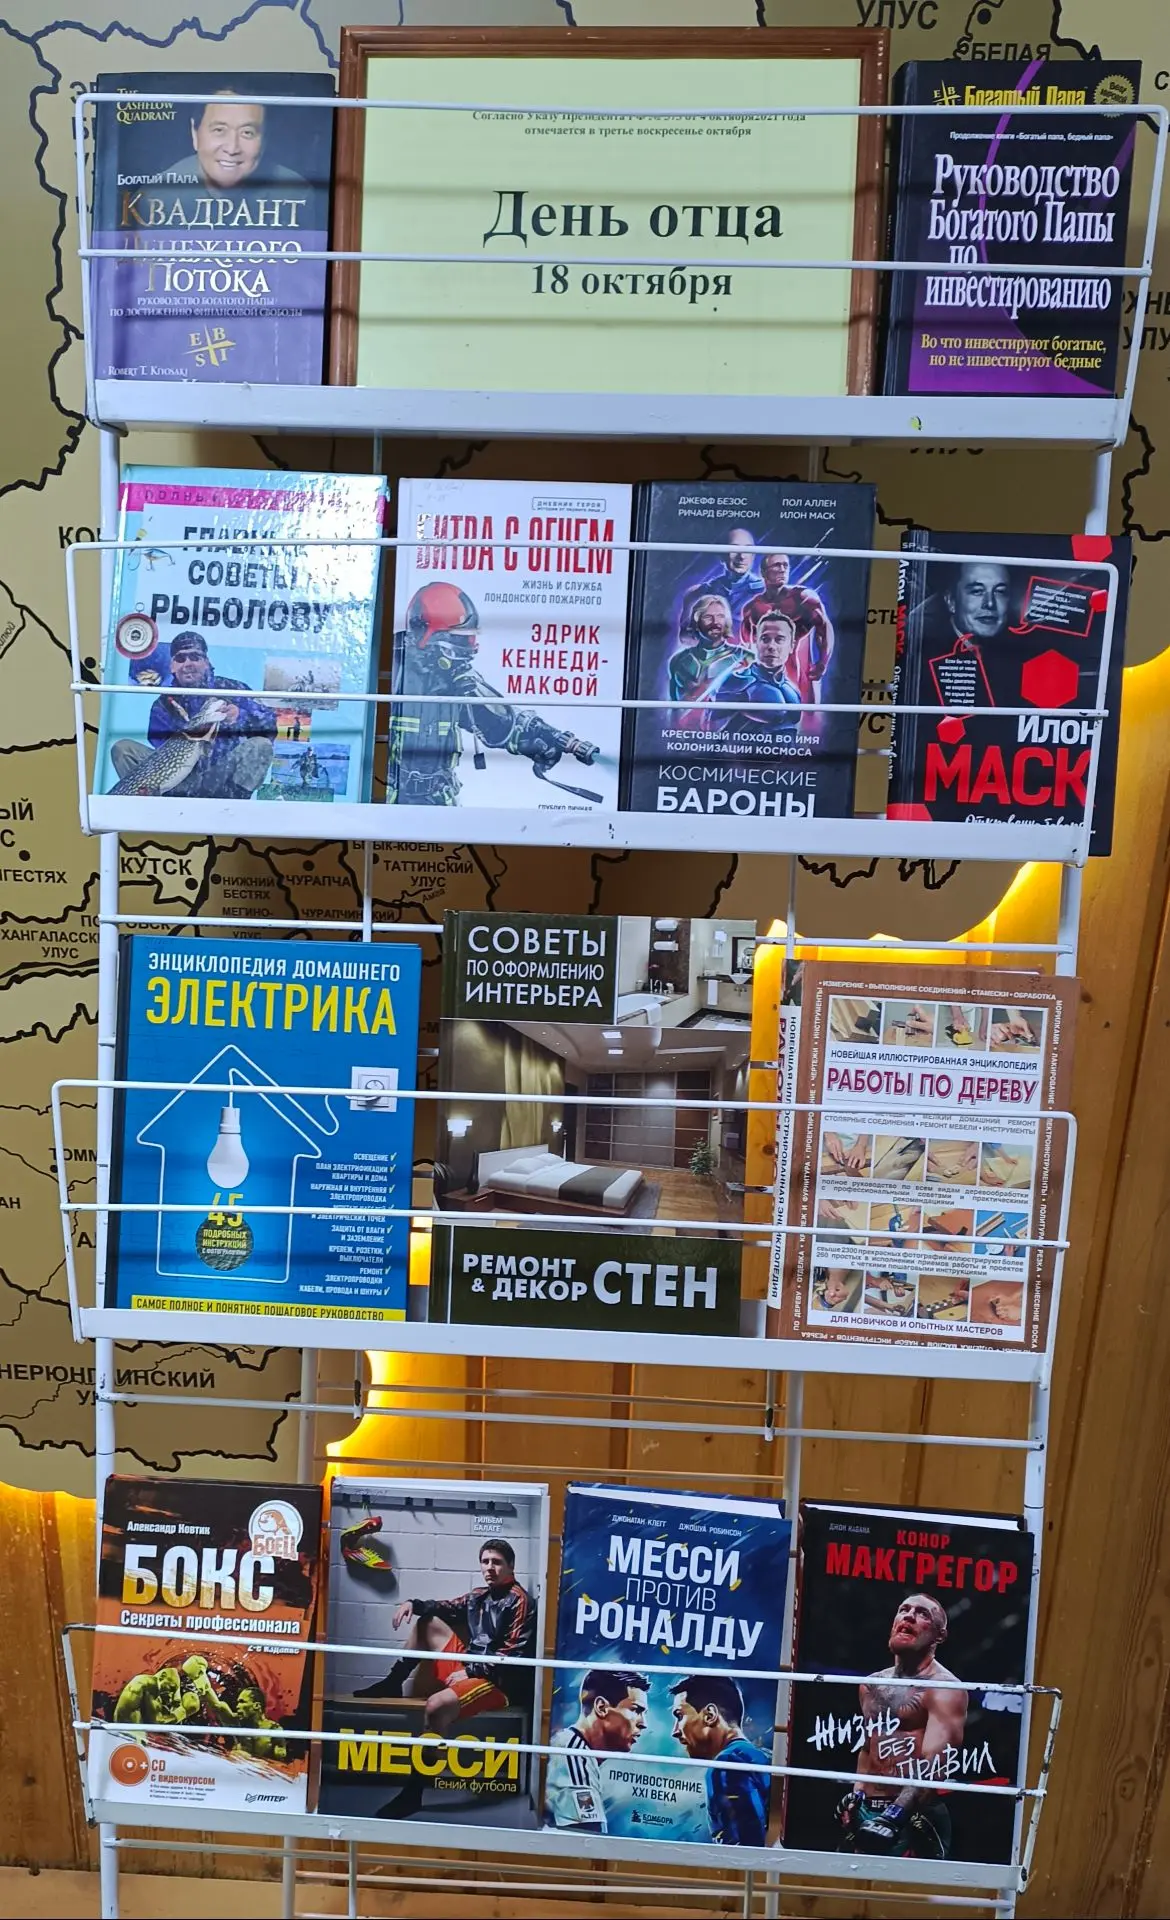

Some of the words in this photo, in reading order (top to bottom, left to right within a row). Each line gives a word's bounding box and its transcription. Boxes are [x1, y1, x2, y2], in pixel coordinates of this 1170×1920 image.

[858, 0, 939, 29] УЛУС
[972, 42, 1051, 60] БЕЛАЯ
[116, 110, 177, 125] QUADRANT
[524, 126, 586, 135] отмечается
[589, 127, 596, 135] в
[599, 126, 634, 138] третье
[637, 127, 704, 138] воскресенье
[706, 125, 752, 138] октября
[117, 172, 163, 186] БОГАТЫЙ
[166, 172, 199, 184] ПАПА
[931, 153, 1121, 208] Руководство
[119, 191, 307, 231] КВАДРАНТ
[482, 189, 630, 249] День
[648, 202, 784, 246] отца
[927, 198, 1039, 243] Богатого
[1042, 200, 1117, 243] Папы
[949, 245, 979, 274] по
[144, 261, 272, 298] ПОТОКА
[530, 263, 570, 296] 18
[581, 265, 734, 305] октября
[924, 275, 1113, 320] инвестированию
[921, 333, 938, 349] Во
[940, 337, 963, 349] что
[964, 337, 1050, 354] инвестируют
[1051, 335, 1107, 354] богатые,
[929, 353, 947, 367] но
[949, 355, 965, 367] не
[966, 354, 1052, 372] инвестируют
[1053, 352, 1102, 371] бедные
[678, 496, 716, 506] ДЖЕФФ
[717, 497, 748, 506] БЕЗОС
[781, 498, 802, 507] ПОЛ
[804, 499, 837, 508] АЛЛЕН
[677, 509, 715, 518] РИЧАРД
[716, 509, 761, 519] БРЭНСОН
[779, 511, 807, 520] ИЛОН
[809, 511, 836, 520] МАСК
[415, 512, 494, 572] БИТВА
[503, 515, 520, 571] С
[521, 580, 555, 590] ЖИЗНЬ
[556, 580, 563, 591] И
[564, 581, 603, 592] СЛУЖБА
[484, 592, 548, 604] ЛОНДОНСКОГО
[549, 594, 602, 606] ПОЖАРНОГО
[149, 592, 331, 634] РЫБОЛОВУ
[530, 622, 600, 645] ЭДРИК
[501, 648, 609, 672] КЕННЕДИ-
[507, 673, 599, 698] МАКФОЙ
[661, 729, 731, 742] КРЕСТОВЫЙ
[733, 732, 774, 745] ПОХОД
[775, 733, 793, 744] ВО
[795, 735, 821, 746] ИМЯ
[1017, 714, 1098, 745] ИЛОН
[666, 741, 753, 755] КОЛОНИЗАЦИИ
[755, 746, 813, 758] КОСМОСА
[658, 764, 819, 788] КОСМИЧЕСКИЕ
[923, 742, 1097, 809] МАСК
[656, 786, 816, 819] БАРОНЫ
[383, 859, 474, 874] ТАТТИНСКИЙ
[222, 876, 276, 888] НИЖНИЙ
[286, 875, 351, 887] ЧУРАПЧА
[410, 875, 446, 888] УЛУС
[223, 889, 271, 900] БЕСТЯХ
[222, 906, 274, 918] МЕГИНО-
[42, 946, 80, 959] УЛУС
[467, 925, 607, 958] СОВЕТЫ
[148, 952, 287, 978] ЭНЦИКЛОПЕДИЯ
[292, 961, 401, 982] ДОМАШНЕГО
[465, 959, 489, 977] ПО
[491, 961, 606, 982] ОФОРМЛЕНИЮ
[465, 980, 604, 1008] ИНТЕРЬЕРА
[918, 985, 967, 996] СОЕДИНЕНИЙ
[1013, 991, 1057, 1001] ОБРАБОТКА
[145, 976, 398, 1036] ЭЛЕКТРИКА
[830, 1049, 878, 1061] НОВЕЙШАЯ
[878, 1053, 968, 1067] ИЛЛЮСТРИРОВАННАЯ
[968, 1059, 1038, 1071] ЭНЦИКЛОПЕДИЯ
[826, 1067, 913, 1097] РАБОТЫ
[918, 1073, 954, 1098] ПО
[956, 1076, 1040, 1106] ДЕРЕВУ
[867, 1117, 915, 1128] СОЕДИНЕНИЯ
[919, 1121, 948, 1130] РЕМОНТ
[207, 1192, 245, 1228] 45
[203, 1228, 248, 1240] ПОДРОБНЫХ
[463, 1253, 577, 1278] РЕМОНТ
[471, 1278, 486, 1294] &
[492, 1277, 588, 1303] ДЕКОР
[593, 1259, 718, 1309] СТЕН
[136, 1298, 168, 1311] САМОЕ
[169, 1300, 204, 1312] ПОЛНОЕ
[206, 1301, 214, 1312] И
[216, 1302, 261, 1315] ПОНЯТНОЕ
[264, 1306, 317, 1318] ПОШАГОВОЕ
[320, 1308, 384, 1321] РУКОВОДСТВО
[830, 1315, 849, 1325] ДЛЯ
[850, 1316, 899, 1328] НОВИЧКОВ
[900, 1320, 907, 1328] И
[908, 1320, 954, 1332] ОПЫТНЫХ
[955, 1324, 1004, 1336] МАСТЕРОВ
[127, 1519, 177, 1535] Александр
[178, 1523, 211, 1536] Ковтик
[473, 1515, 503, 1525] ГИЛЬЕМ
[473, 1523, 502, 1533] БАЛАГЕ
[611, 1514, 646, 1526] ДЖОНАТАН
[647, 1518, 667, 1528] КЛЕГГ
[678, 1522, 707, 1533] ДЖОШУА
[709, 1526, 742, 1537] РОБИНСОН
[251, 1533, 299, 1561] БОЕЦ
[896, 1529, 950, 1550] КОНОР
[608, 1534, 741, 1588] МЕССИ
[825, 1542, 1019, 1594] МАКГРЕГОР
[121, 1543, 276, 1613] БОКС
[625, 1577, 717, 1612] ПРОТИВ
[120, 1609, 183, 1628] Секреты
[185, 1614, 301, 1635] профессионала
[575, 1597, 765, 1661] РОНАЛДУ
[806, 1706, 901, 1753] ЖИЗНЬ
[337, 1727, 519, 1779] МЕССИ
[878, 1736, 916, 1760] БЕЗ
[151, 1759, 166, 1772] CD
[896, 1741, 997, 1782] ПРАВИЛ
[158, 1774, 216, 1786] видеокурсом
[433, 1777, 467, 1790] Гений
[469, 1778, 517, 1793] футбола
[609, 1769, 702, 1793] ПРОТИВОСТОЯНИЕ
[256, 1793, 286, 1803] ПИТЕР
[631, 1786, 649, 1799] XXI
[650, 1789, 677, 1803] ВЕКА
[642, 1813, 674, 1826] БОМБОРА
